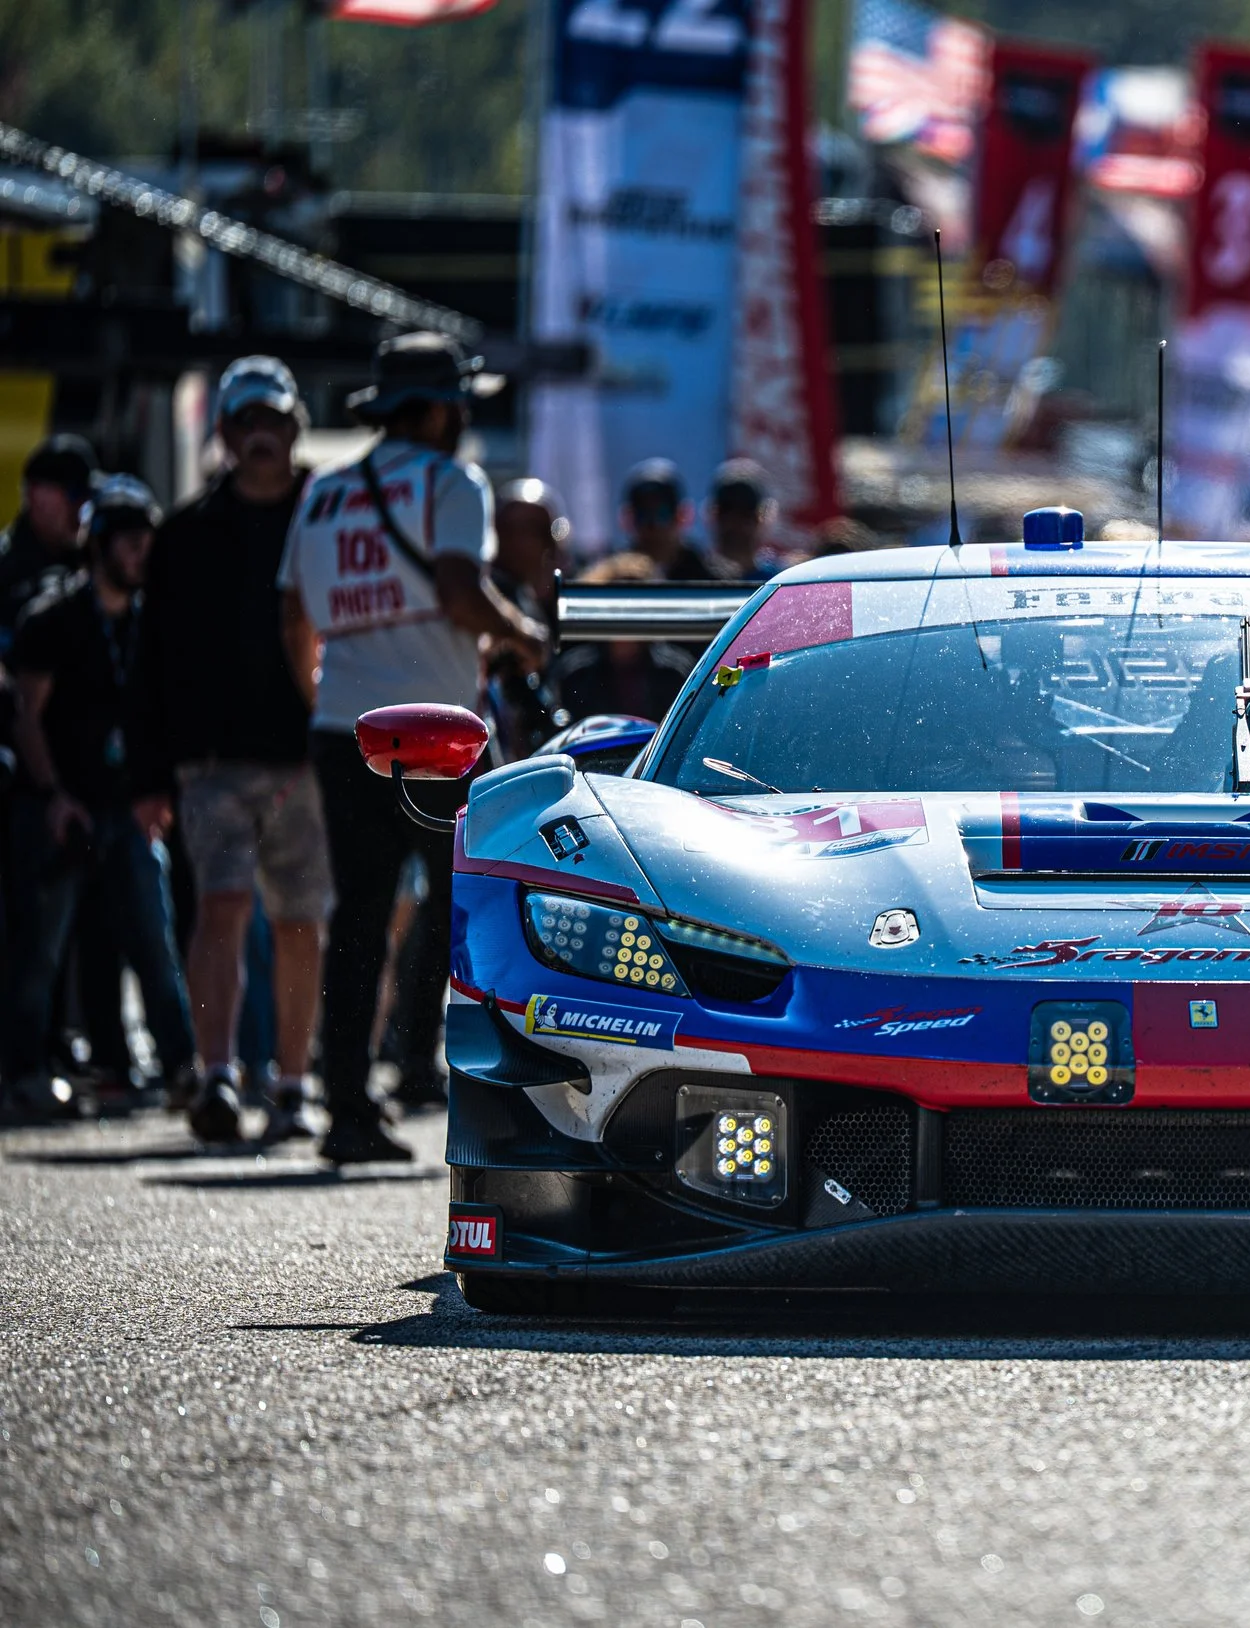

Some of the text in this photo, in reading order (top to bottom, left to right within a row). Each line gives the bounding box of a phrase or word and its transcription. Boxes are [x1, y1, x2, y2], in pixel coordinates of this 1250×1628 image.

[1157, 902, 1243, 917] 10
[560, 1011, 662, 1037] MICHELIN
[874, 1014, 975, 1036] Speed
